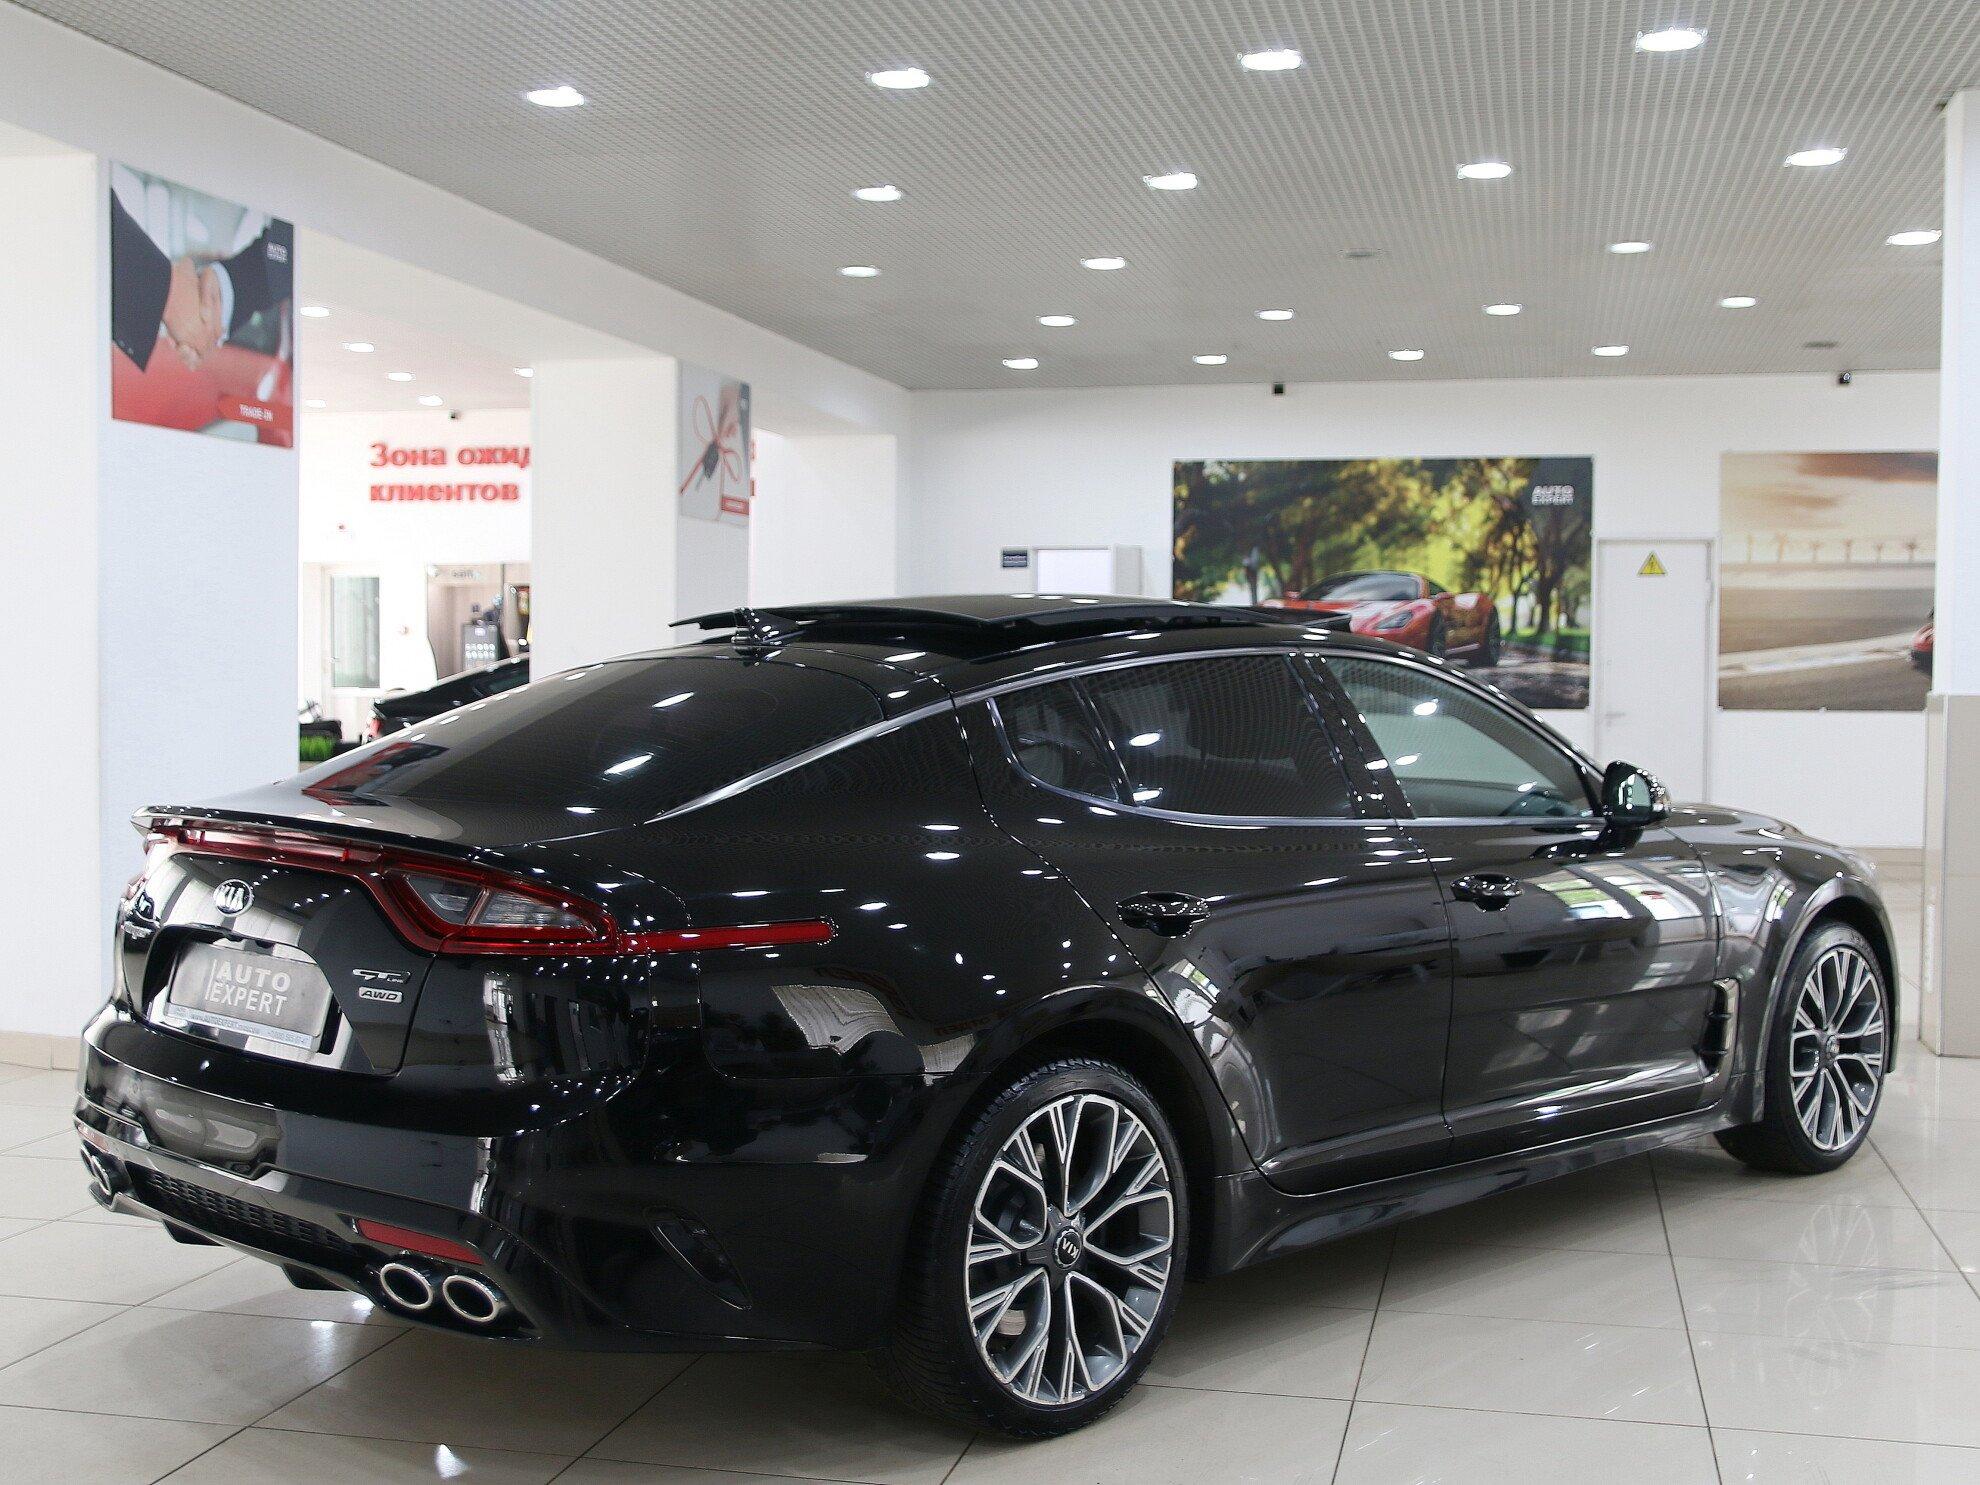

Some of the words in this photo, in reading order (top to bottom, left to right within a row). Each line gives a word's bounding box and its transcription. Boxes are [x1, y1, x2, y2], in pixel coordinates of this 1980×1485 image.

[370, 442, 447, 467] Зона
[370, 484, 519, 502] клиентов
[1533, 485, 1575, 496] AUTO
[216, 885, 244, 911] KIA
[215, 959, 291, 992] AUTO
[209, 981, 287, 1015] EXPERT
[361, 990, 398, 1001] AWD
[1062, 1237, 1079, 1259] KIA
